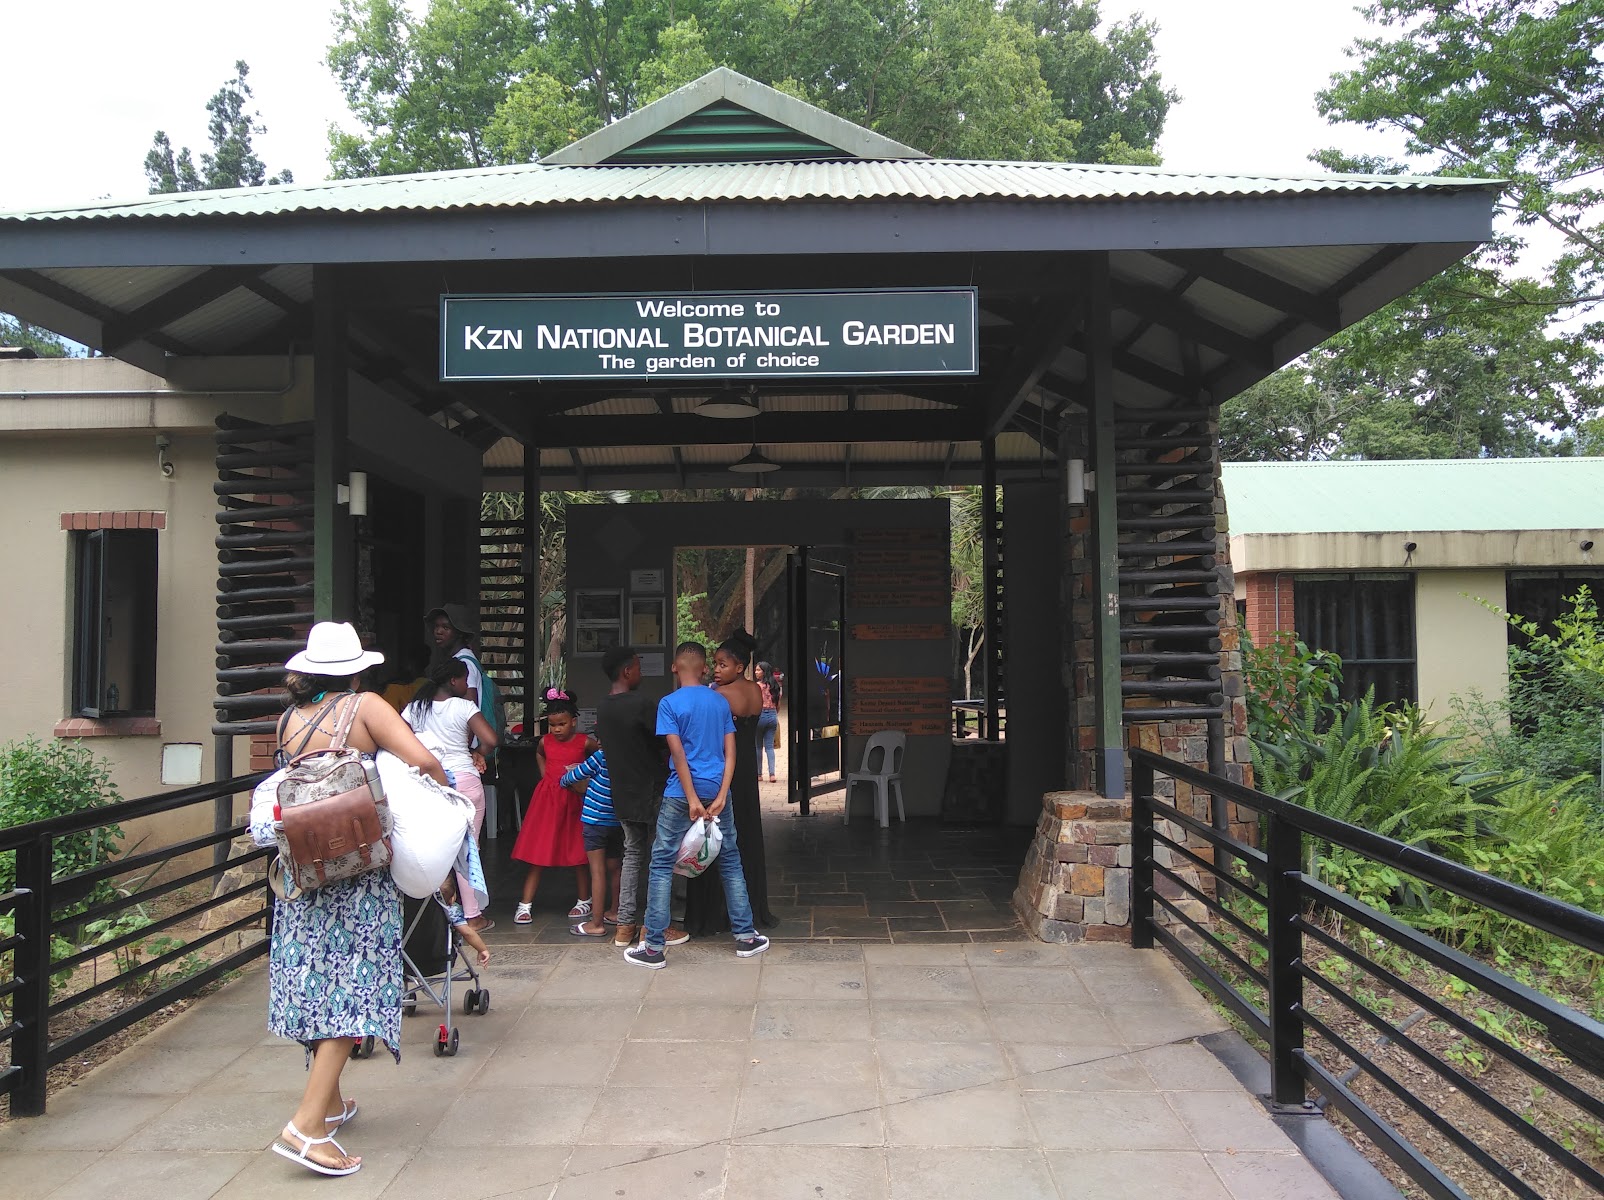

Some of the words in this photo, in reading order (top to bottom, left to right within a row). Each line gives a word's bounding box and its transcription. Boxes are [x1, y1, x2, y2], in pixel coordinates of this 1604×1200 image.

[635, 300, 745, 318] Welcome
[754, 301, 781, 317] to
[464, 325, 523, 350] KZN
[537, 324, 670, 350] NATIONAL
[683, 322, 830, 348] BOTANICAL
[842, 320, 955, 346] GARDEN
[598, 354, 636, 369] The
[645, 353, 716, 372] garden
[726, 353, 747, 368] of
[756, 352, 820, 368] choice
